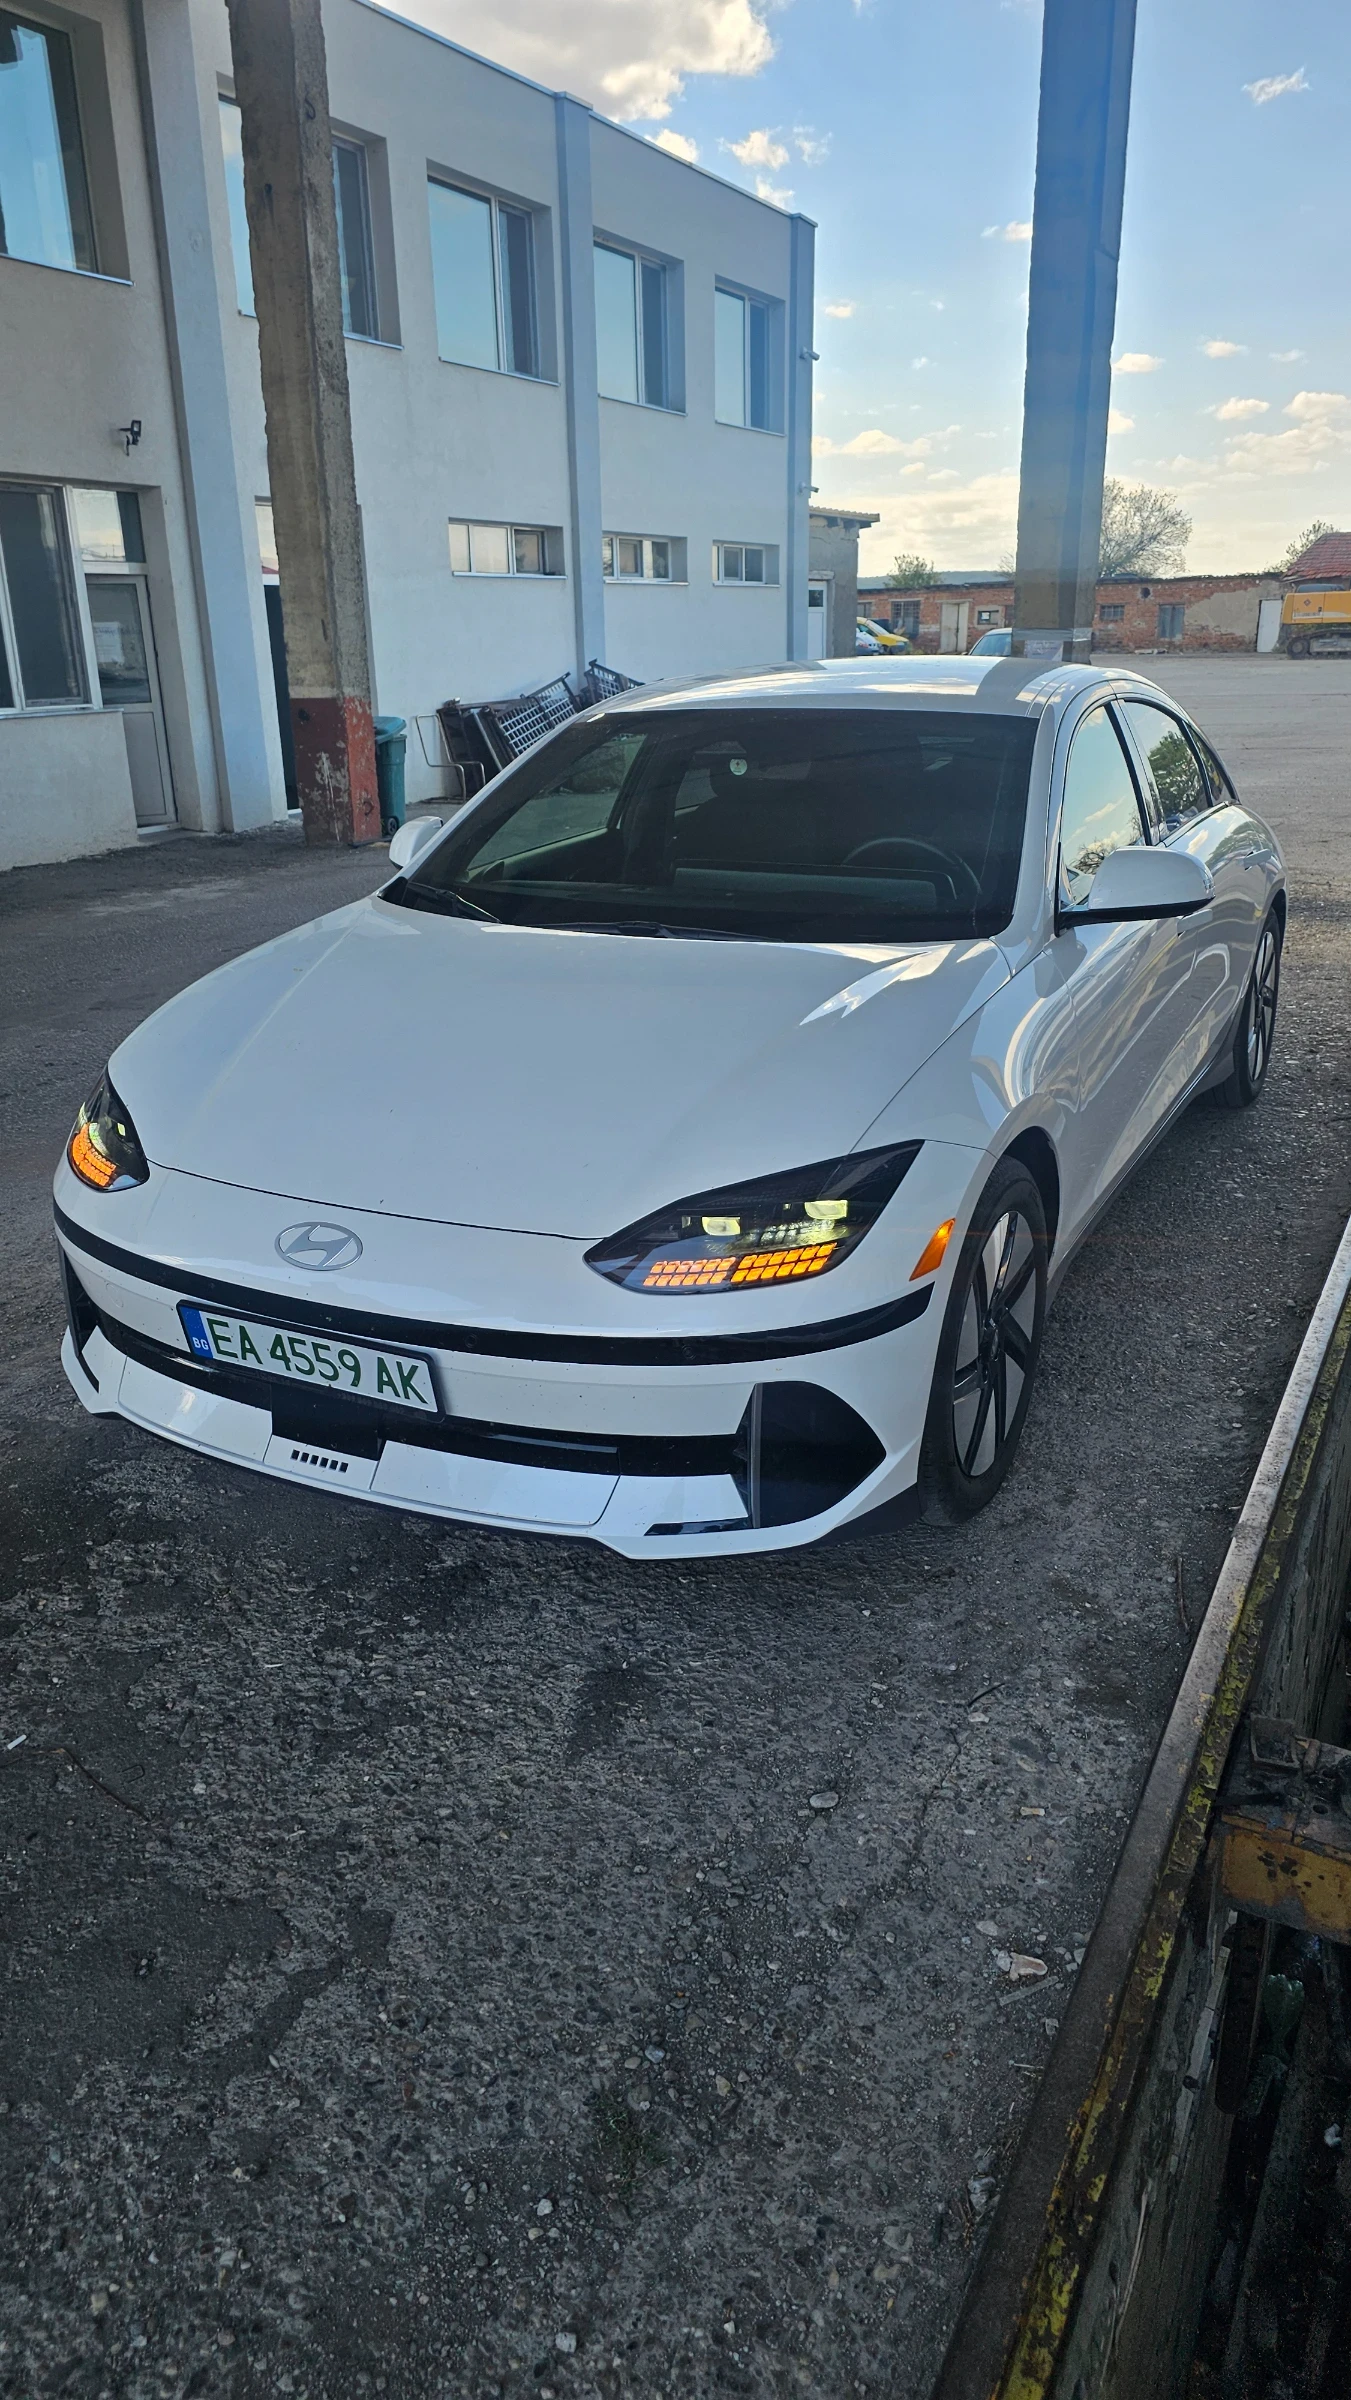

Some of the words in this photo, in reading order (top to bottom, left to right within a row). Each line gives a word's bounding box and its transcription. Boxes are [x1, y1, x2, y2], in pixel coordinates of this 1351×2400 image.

[192, 1336, 209, 1350] BG
[207, 1317, 263, 1365] EA
[270, 1333, 361, 1387] 4559
[377, 1356, 429, 1404] AK
